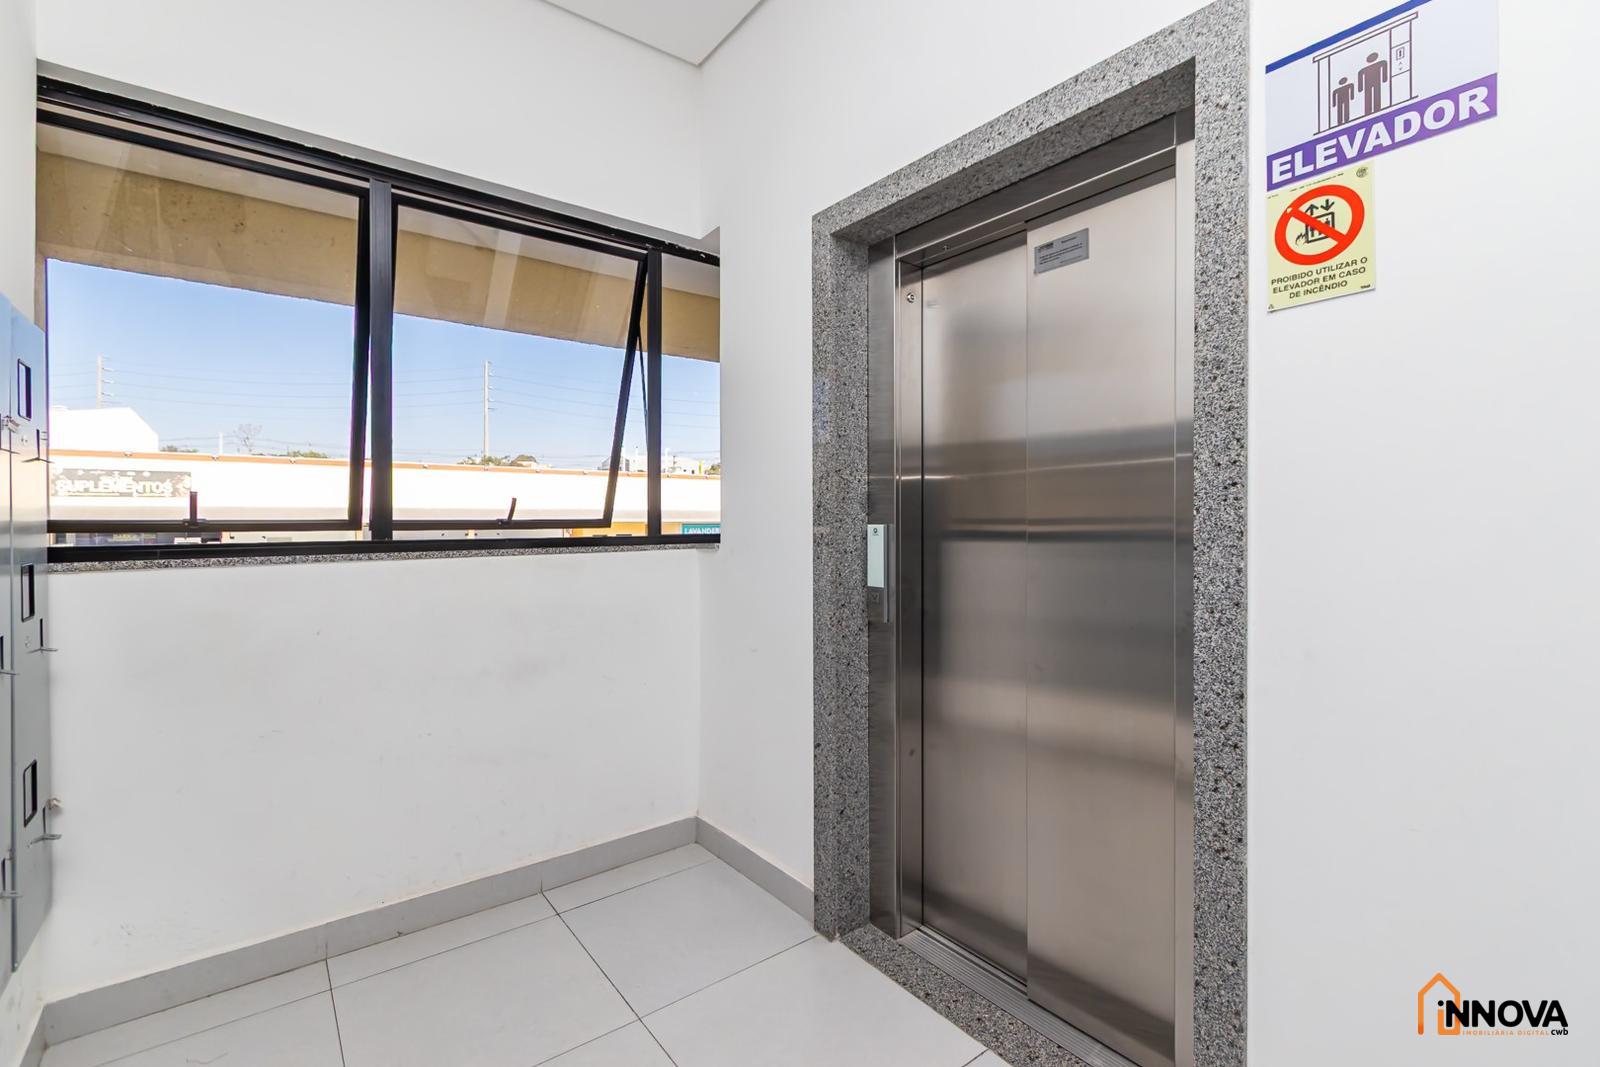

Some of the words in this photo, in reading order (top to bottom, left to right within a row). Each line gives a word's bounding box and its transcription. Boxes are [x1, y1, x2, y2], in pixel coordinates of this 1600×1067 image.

[1271, 86, 1490, 184] ELEVADOR
[1271, 270, 1314, 285] PROIBIDO
[1315, 259, 1358, 275] UTILIZAR
[1360, 256, 1368, 264] O
[1272, 278, 1320, 294] ELEVADOR
[1322, 274, 1336, 282] EM
[1338, 266, 1366, 278] CASO
[1304, 280, 1348, 295] INCÊNDIO
